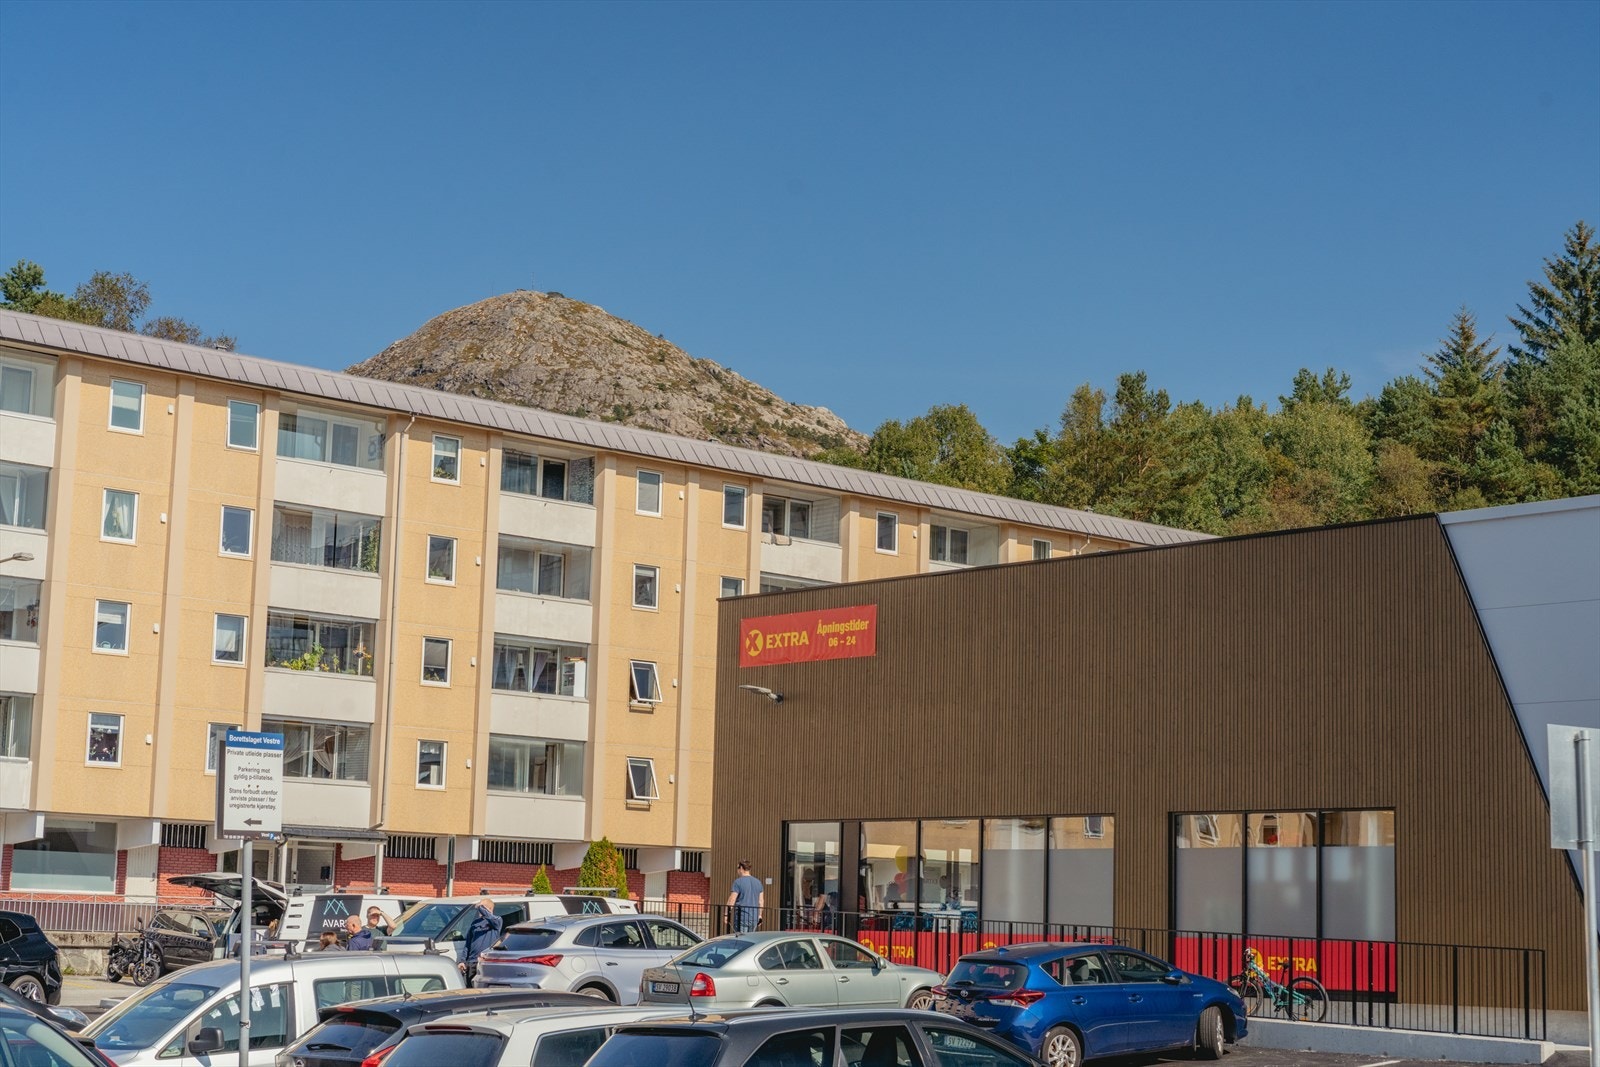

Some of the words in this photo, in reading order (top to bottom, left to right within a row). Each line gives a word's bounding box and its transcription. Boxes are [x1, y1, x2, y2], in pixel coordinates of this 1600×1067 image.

[817, 619, 869, 636] Åpningstider
[766, 631, 809, 649] EXTRA
[828, 637, 838, 647] 06
[846, 636, 856, 646] 24
[229, 734, 262, 744] Borettslaget
[238, 766, 260, 774] Parkering
[322, 919, 346, 928] AVAR
[1267, 956, 1318, 972] EXTRA
